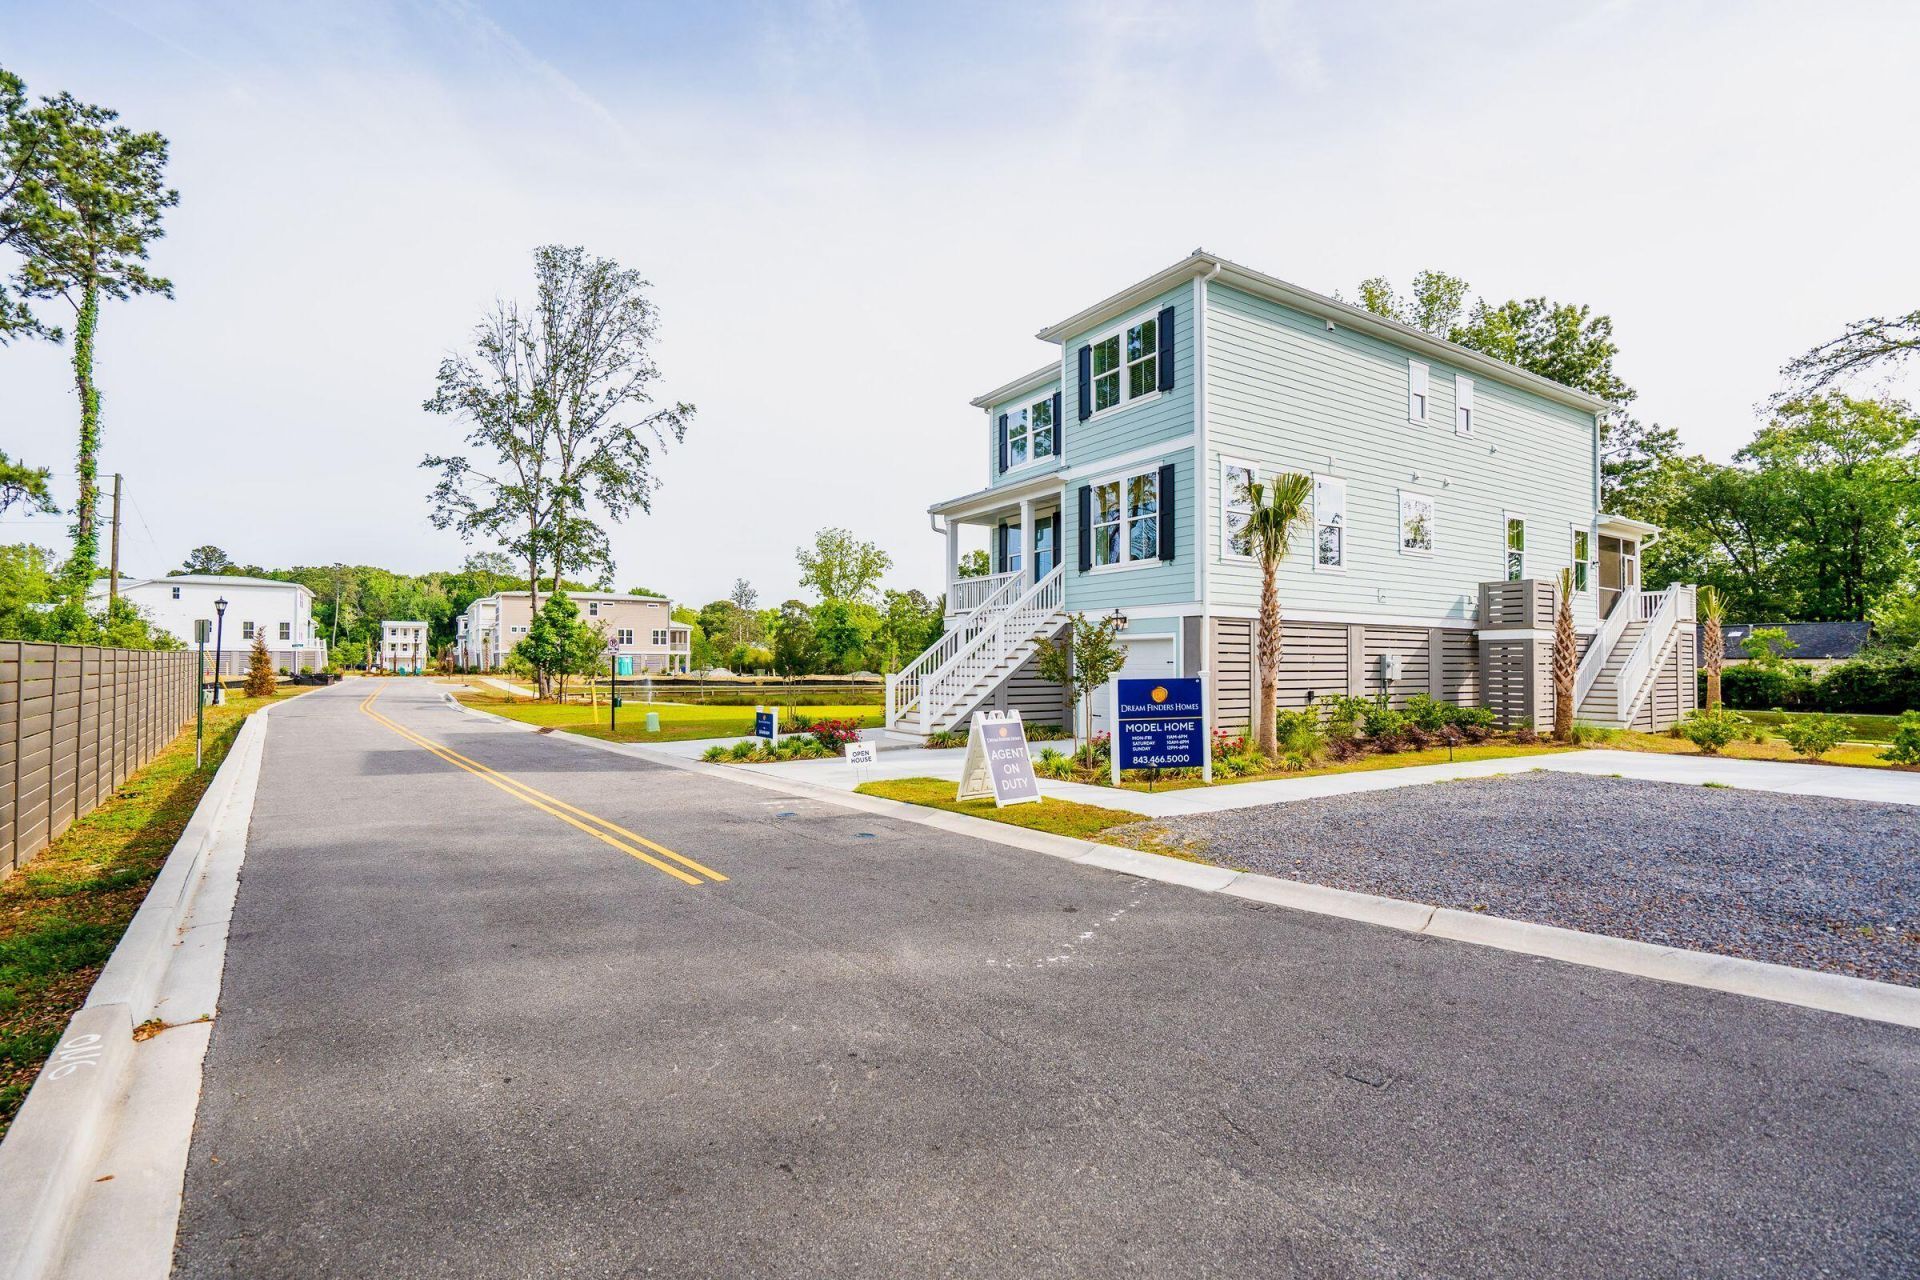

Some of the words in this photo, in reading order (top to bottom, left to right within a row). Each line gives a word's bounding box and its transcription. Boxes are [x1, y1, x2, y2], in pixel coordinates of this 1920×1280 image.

[1121, 704, 1146, 713] DREAM
[1147, 703, 1174, 712] FINDERS
[1175, 703, 1199, 711] HOMES
[1125, 723, 1162, 732] MODEL
[1164, 722, 1195, 731] HOME
[991, 747, 1024, 760] AGENT
[851, 756, 872, 764] HOUSE
[1132, 754, 1190, 764] 843.466.5000
[1003, 763, 1020, 775] ON
[1001, 777, 1028, 790] DUTY
